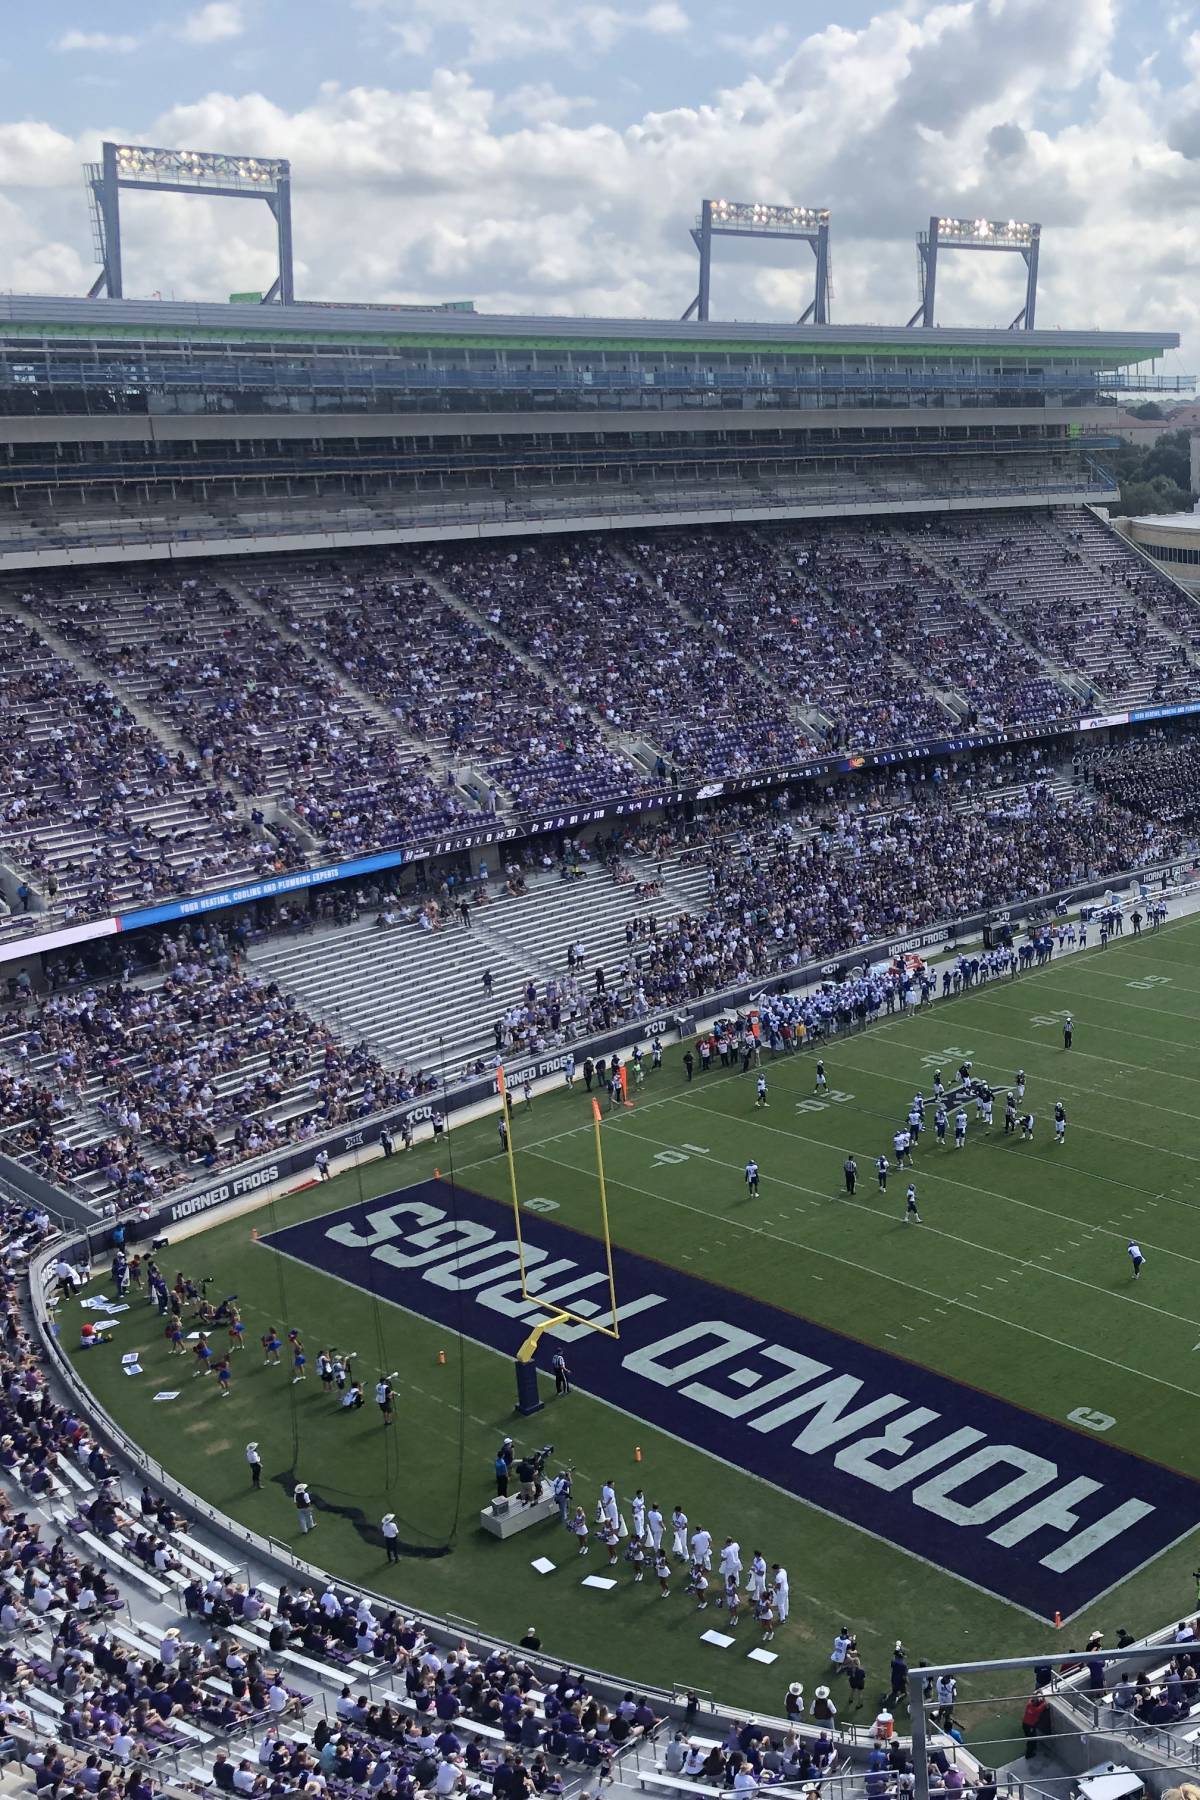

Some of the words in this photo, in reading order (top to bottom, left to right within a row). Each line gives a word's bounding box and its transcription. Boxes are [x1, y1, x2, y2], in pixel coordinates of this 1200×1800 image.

[506, 828, 517, 838] 37
[180, 903, 199, 914] YOUR
[233, 886, 262, 901] COOLING
[263, 883, 277, 893] AND
[277, 875, 311, 891] PLUMBING
[312, 868, 340, 882] EXPERTS
[888, 937, 921, 957] HORNED
[922, 929, 949, 946] FROGS
[1126, 974, 1173, 990] 50
[1031, 1009, 1075, 1025] 40
[644, 1020, 667, 1038] TCU
[930, 1047, 975, 1065] 30
[795, 1090, 856, 1111] 20
[406, 1106, 433, 1125] TCU
[656, 1143, 711, 1165] 10
[171, 1185, 230, 1221] HORNED
[233, 1165, 279, 1195] FROGS
[323, 1201, 668, 1343] FROGS
[1066, 1407, 1118, 1432] G
[622, 1320, 1156, 1573] HORNED
